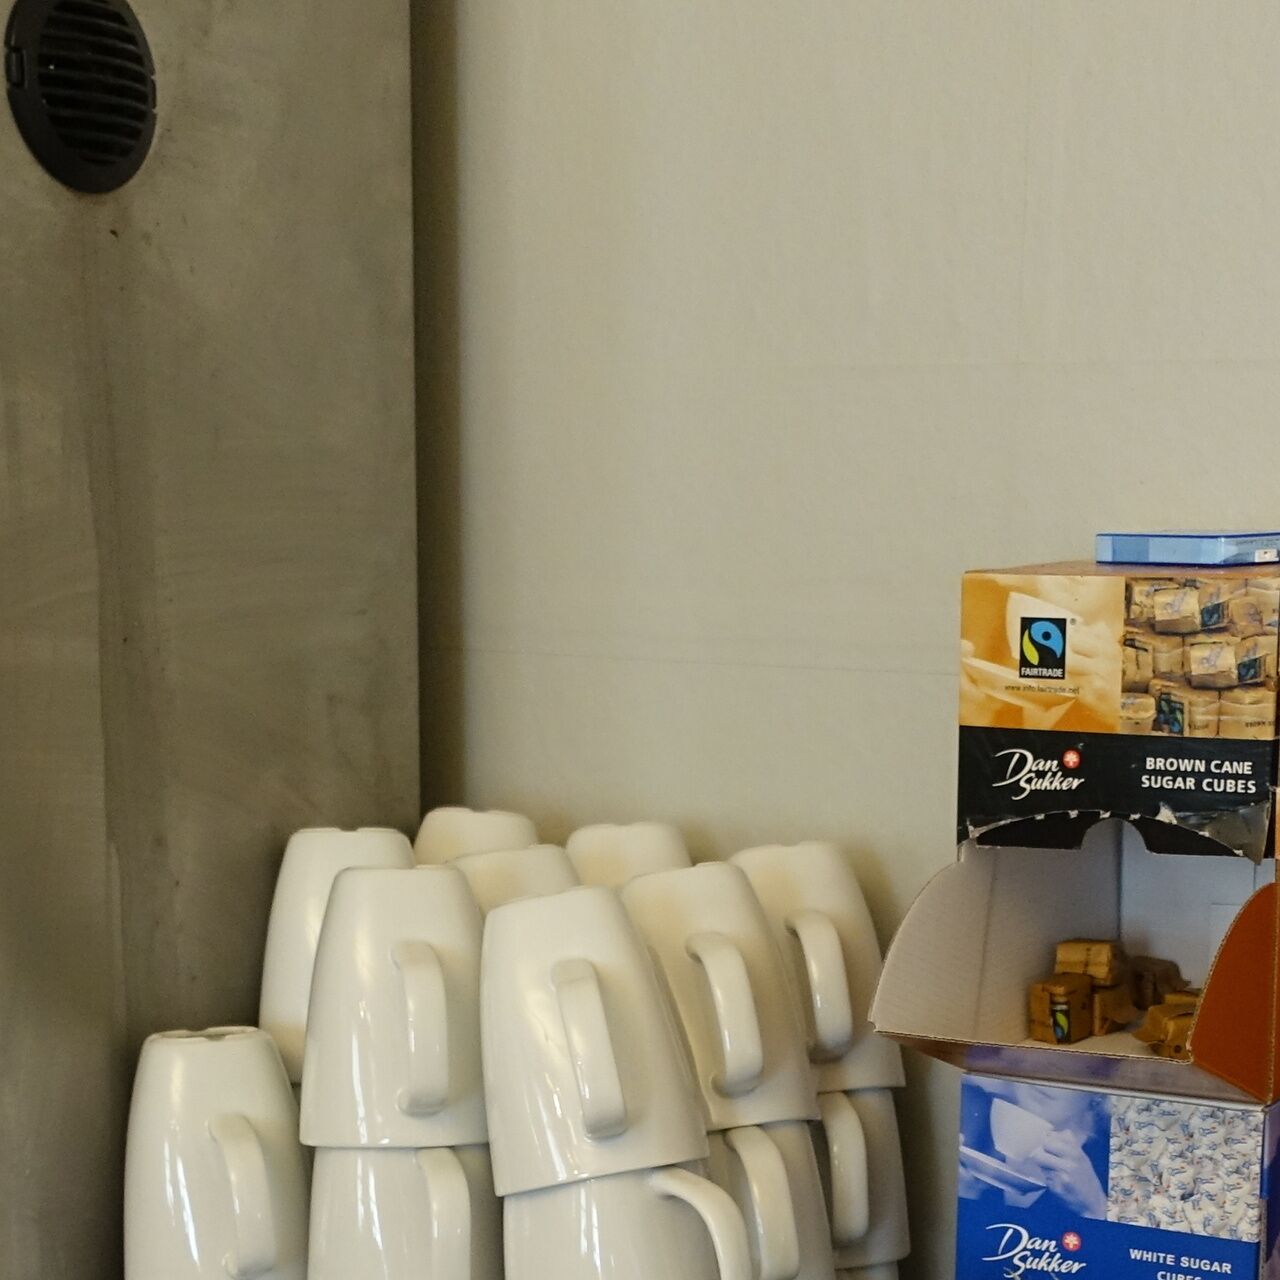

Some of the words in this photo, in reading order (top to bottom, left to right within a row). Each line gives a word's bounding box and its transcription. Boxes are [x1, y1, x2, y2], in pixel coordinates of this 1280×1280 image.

[1021, 666, 1063, 678] FAIRTRADE
[992, 748, 1059, 788] Dan
[1145, 757, 1206, 773] BROWN
[1210, 760, 1253, 775] CANE
[1011, 771, 1085, 800] Sukker
[1141, 775, 1196, 791] SUGAR
[1201, 777, 1257, 794] CUBES
[982, 1223, 1057, 1262] Dan
[1003, 1251, 1087, 1279] Sukker
[1129, 1248, 1175, 1266] WHITE
[1180, 1255, 1232, 1275] SUGAR
